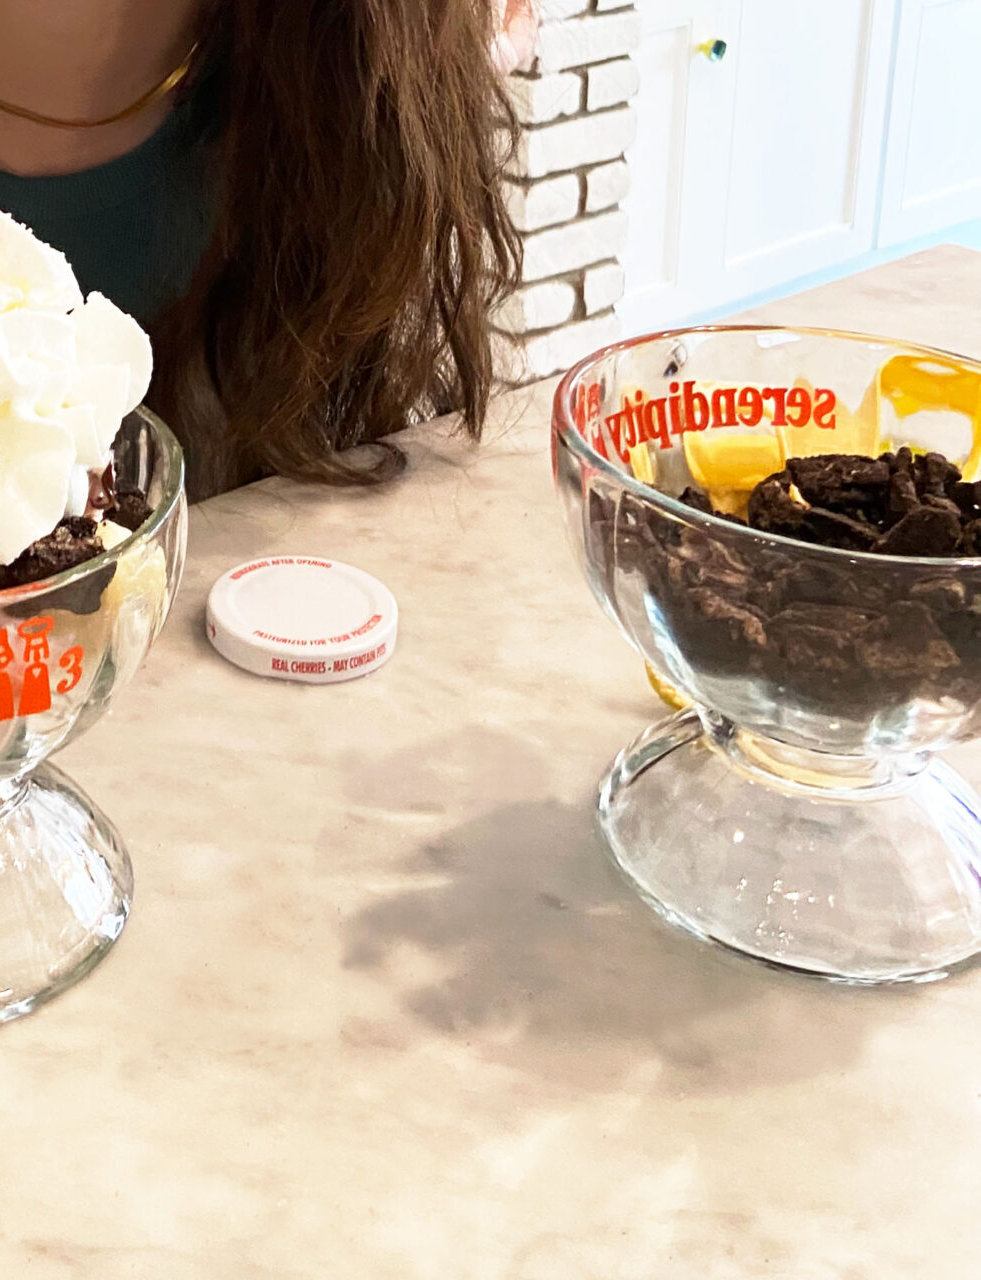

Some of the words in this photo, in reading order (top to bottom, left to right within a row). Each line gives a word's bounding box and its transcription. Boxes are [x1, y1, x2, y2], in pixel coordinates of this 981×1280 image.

[56, 644, 85, 694] 3
[271, 657, 289, 672] REAL
[290, 660, 326, 674] CHERRIES
[333, 659, 349, 673] MAY
[349, 650, 376, 669] CONTAIN
